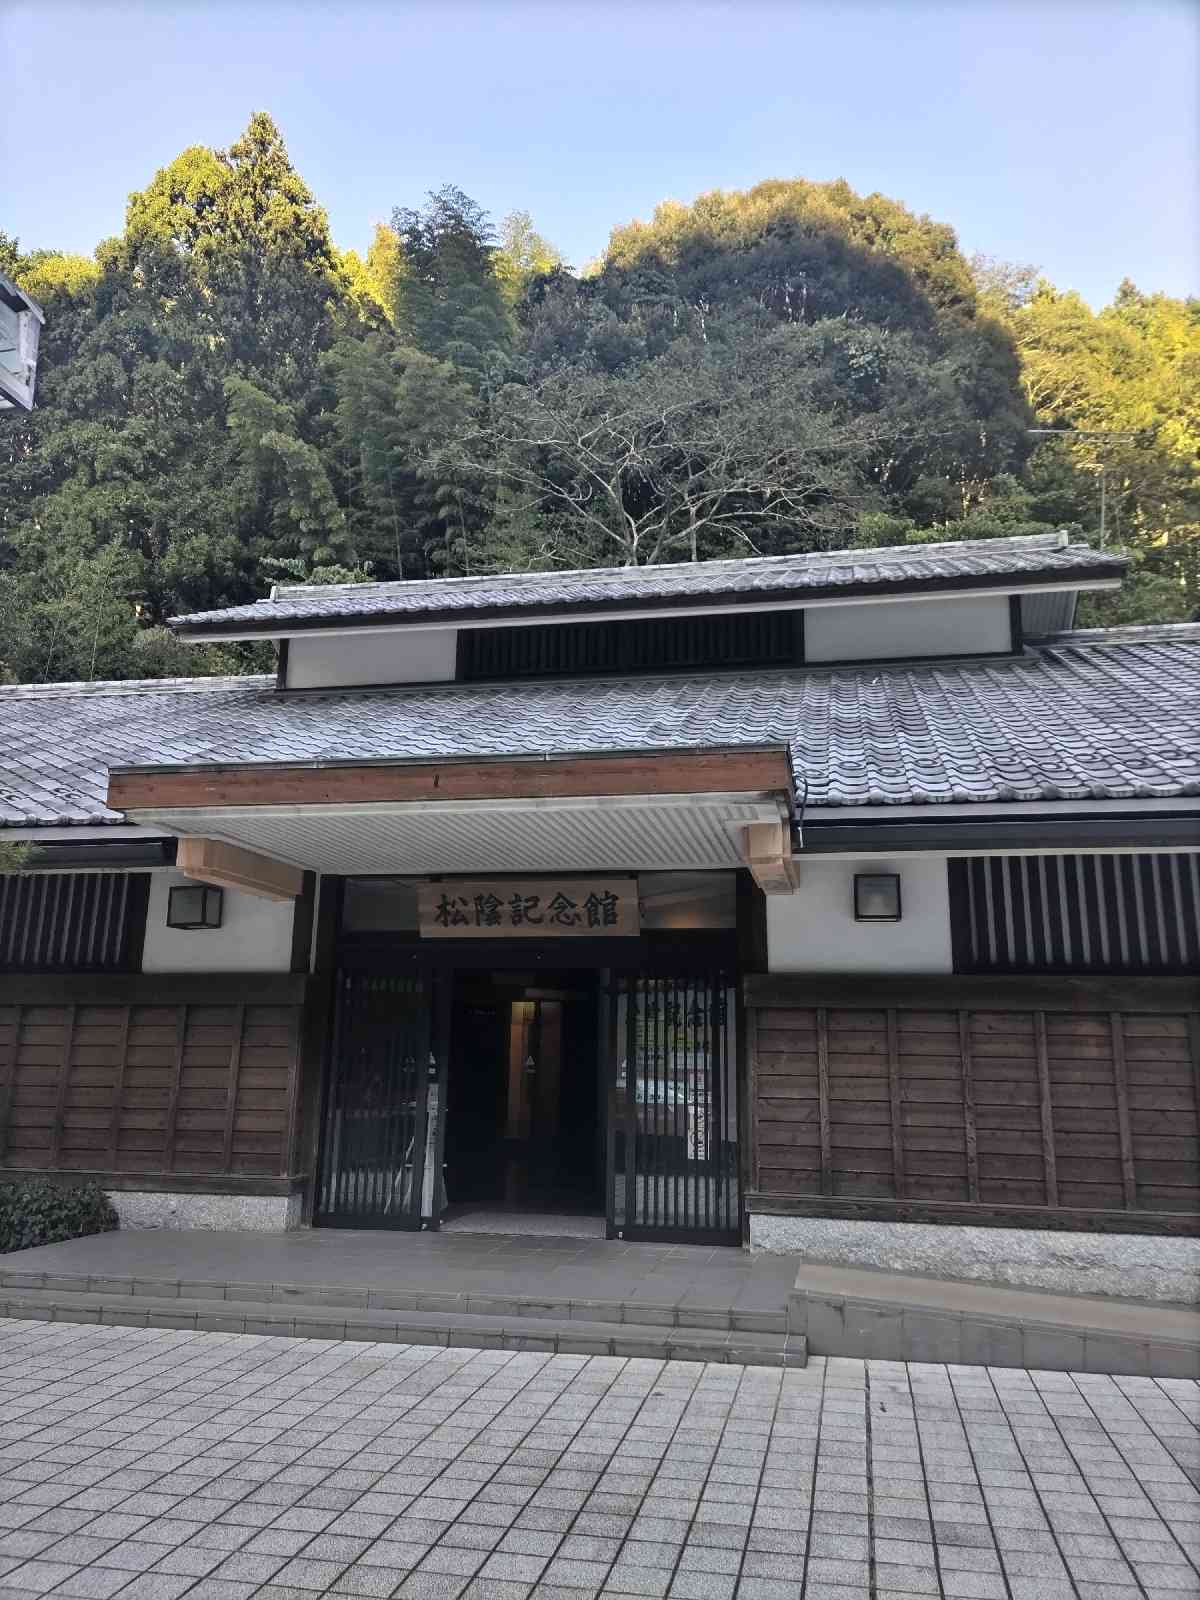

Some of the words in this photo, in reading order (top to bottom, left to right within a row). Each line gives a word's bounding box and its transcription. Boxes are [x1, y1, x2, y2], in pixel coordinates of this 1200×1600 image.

[434, 890, 619, 928] 松陰記念館
